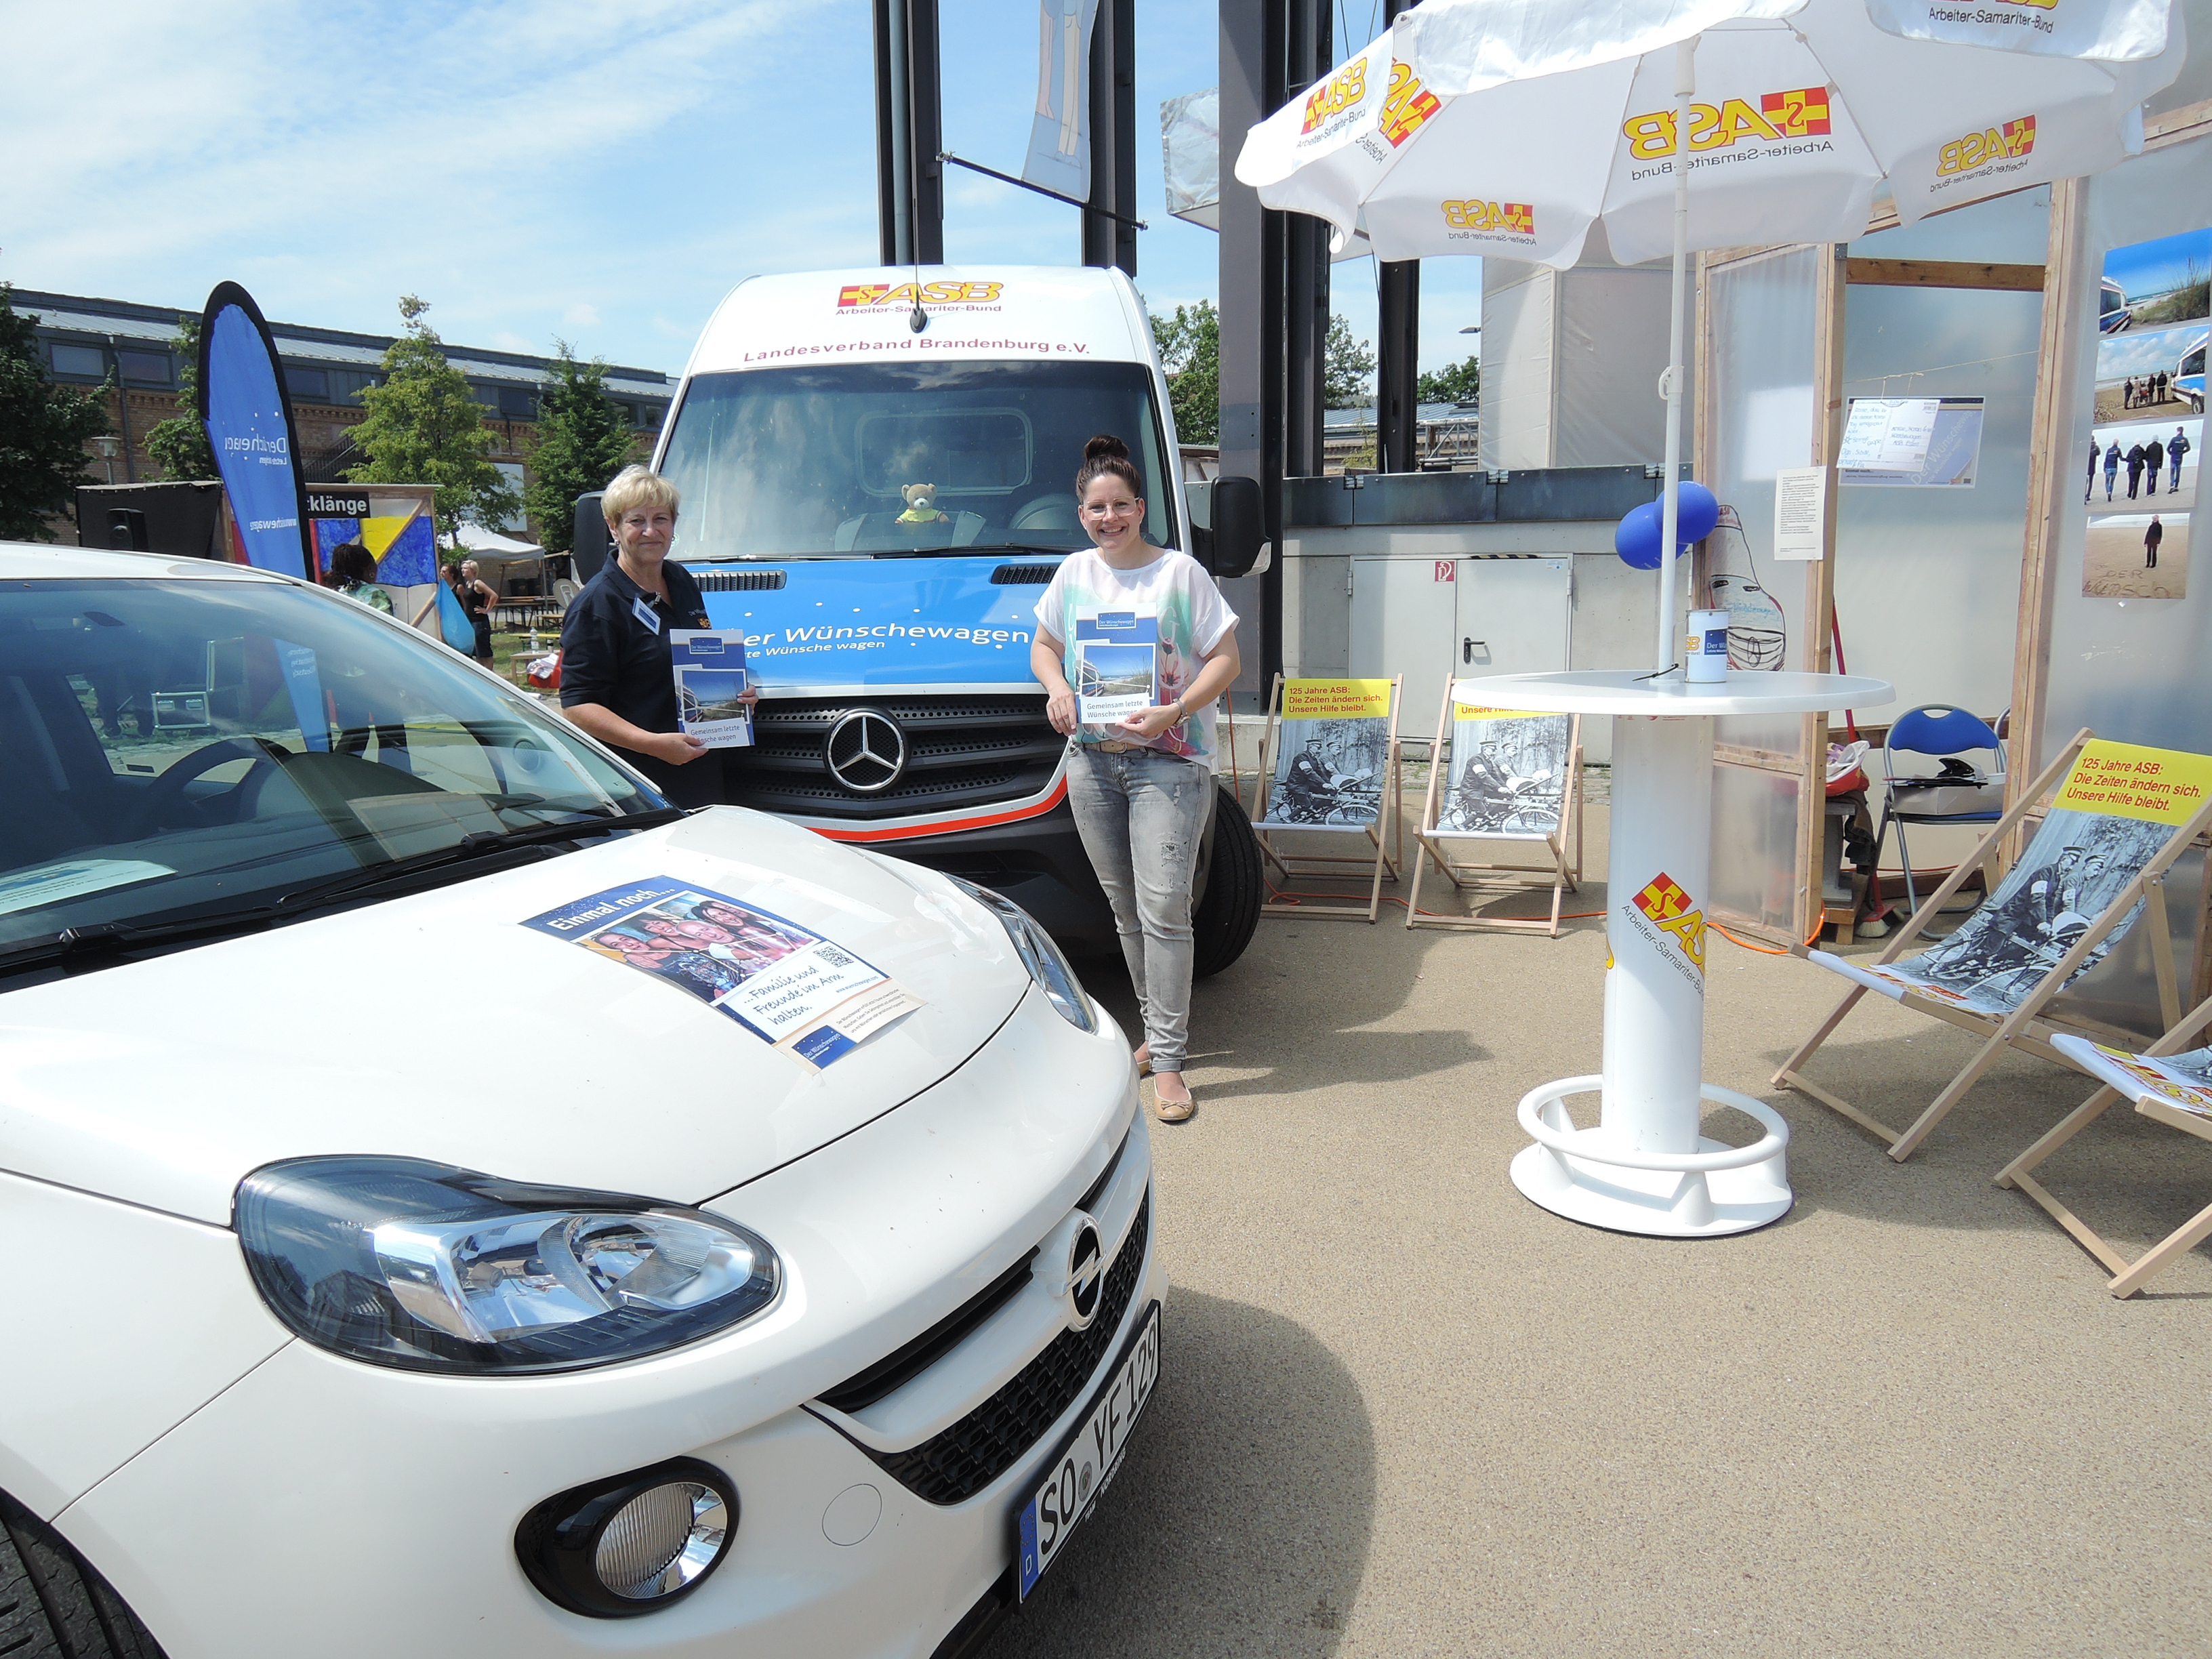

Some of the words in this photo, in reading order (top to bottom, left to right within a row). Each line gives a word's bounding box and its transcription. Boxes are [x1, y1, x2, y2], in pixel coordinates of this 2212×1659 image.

[1929, 7, 2054, 33] Arbeiter-Samariter-Bund
[1317, 57, 1368, 127] ASB
[873, 281, 1004, 305] ASB
[836, 305, 1002, 316] Arbeiter-Saariter-Bund
[743, 339, 912, 362] Landesverband
[920, 338, 1050, 353] Brandenburg
[1056, 342, 1090, 354] e.V.
[743, 632, 777, 647] er
[785, 623, 1030, 644] Wünschewagen
[765, 643, 832, 657] Wünsche
[836, 639, 886, 651] wagen
[1330, 686, 1351, 694] ASB:
[1087, 710, 1116, 718] Wünsche
[691, 726, 723, 736] Gemeinsam
[718, 734, 737, 742] wagen
[2081, 757, 2101, 769] 125
[2101, 760, 2132, 773] Jahre
[2133, 762, 2164, 775] ASB:
[2073, 773, 2093, 785] Die
[2093, 775, 2128, 788] Zeiten
[2129, 777, 2171, 794] ändern
[2173, 783, 2201, 798] sich.
[2066, 787, 2105, 802] Unsere
[2106, 792, 2133, 805] Hilfe
[2134, 795, 2170, 811] bleibt.
[546, 901, 621, 930] Einmal
[615, 888, 676, 907] noch...
[794, 965, 819, 980] und
[753, 986, 804, 1015] Freunde
[797, 983, 820, 993] im
[819, 973, 844, 987] Arm
[767, 1004, 813, 1025] halten.
[1040, 1456, 1076, 1555] SO
[1093, 1380, 1122, 1471] YF
[1126, 1320, 1158, 1419] 129
[1025, 1553, 1033, 1577] D
